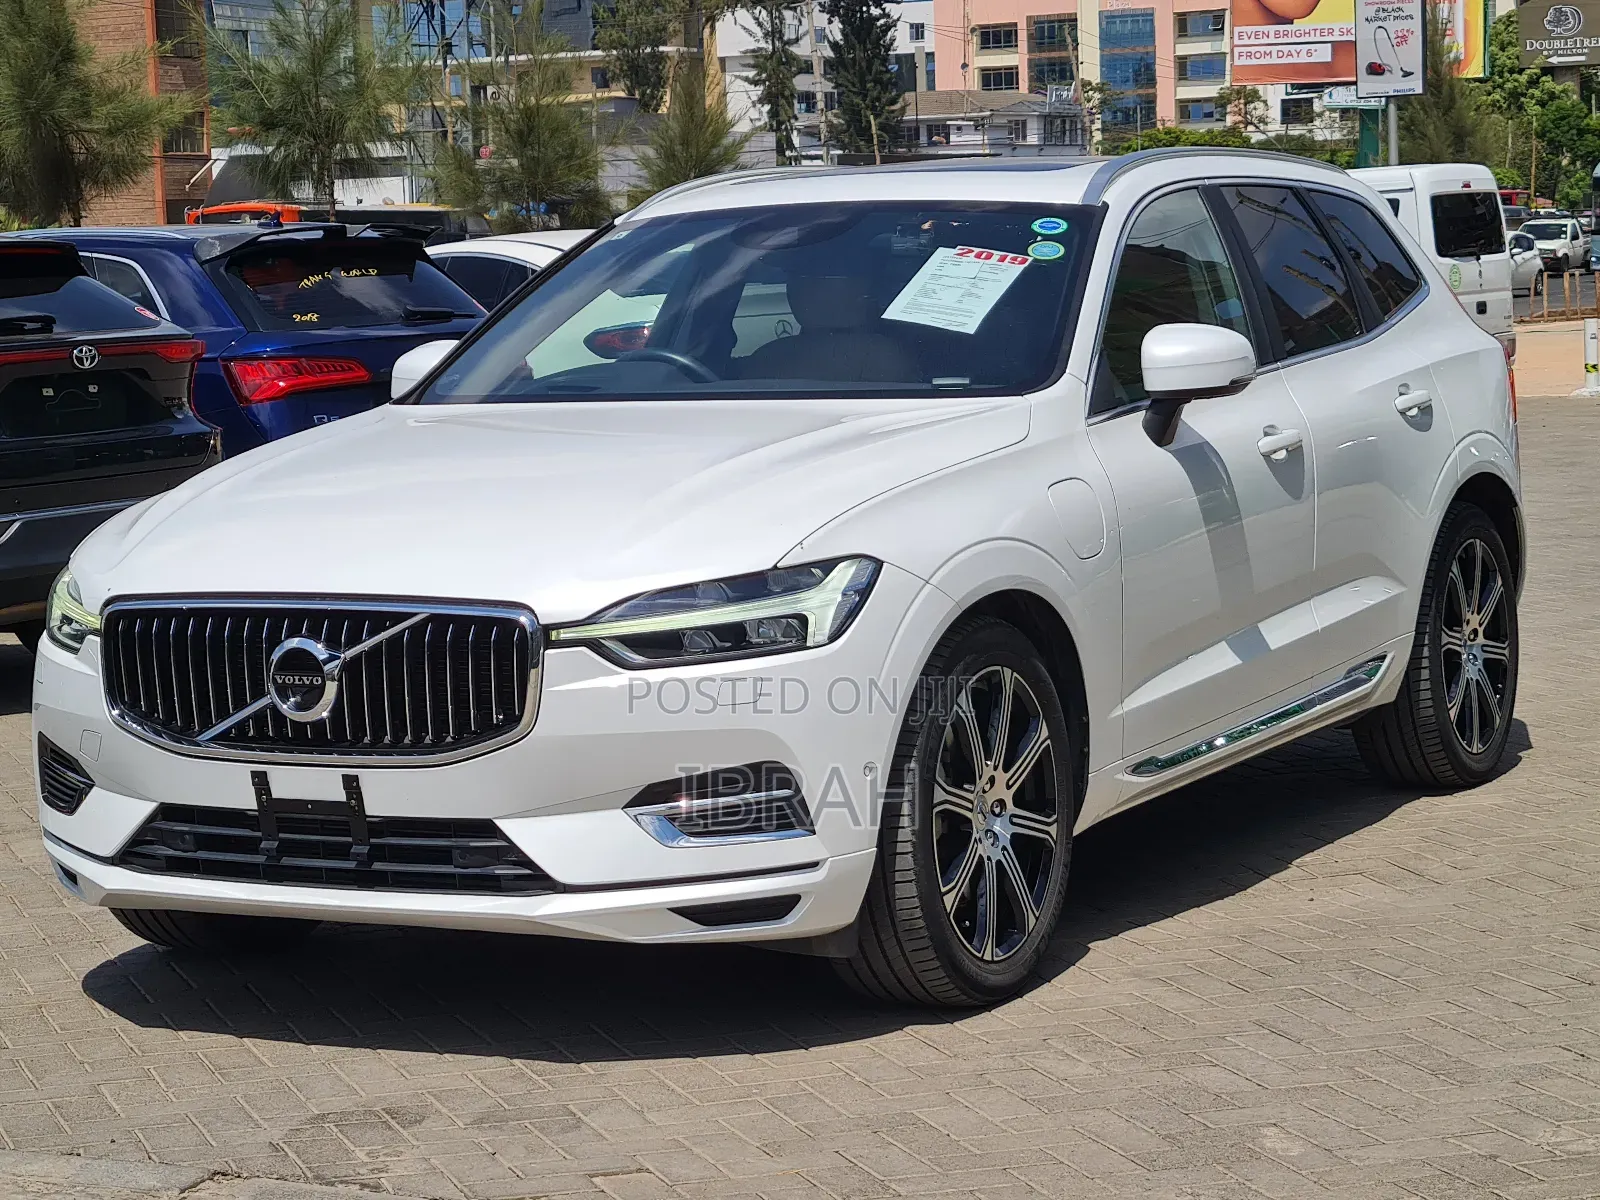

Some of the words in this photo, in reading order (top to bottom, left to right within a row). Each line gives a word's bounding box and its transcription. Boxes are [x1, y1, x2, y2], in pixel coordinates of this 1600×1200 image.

[1237, 31, 1270, 40] EVEN
[1273, 27, 1335, 39] BRIGHTER
[1237, 50, 1273, 60] FROM
[1276, 49, 1303, 59] DAY
[953, 247, 1029, 266] 2019
[292, 312, 320, 322] 2018
[274, 675, 322, 685] VOLVO
